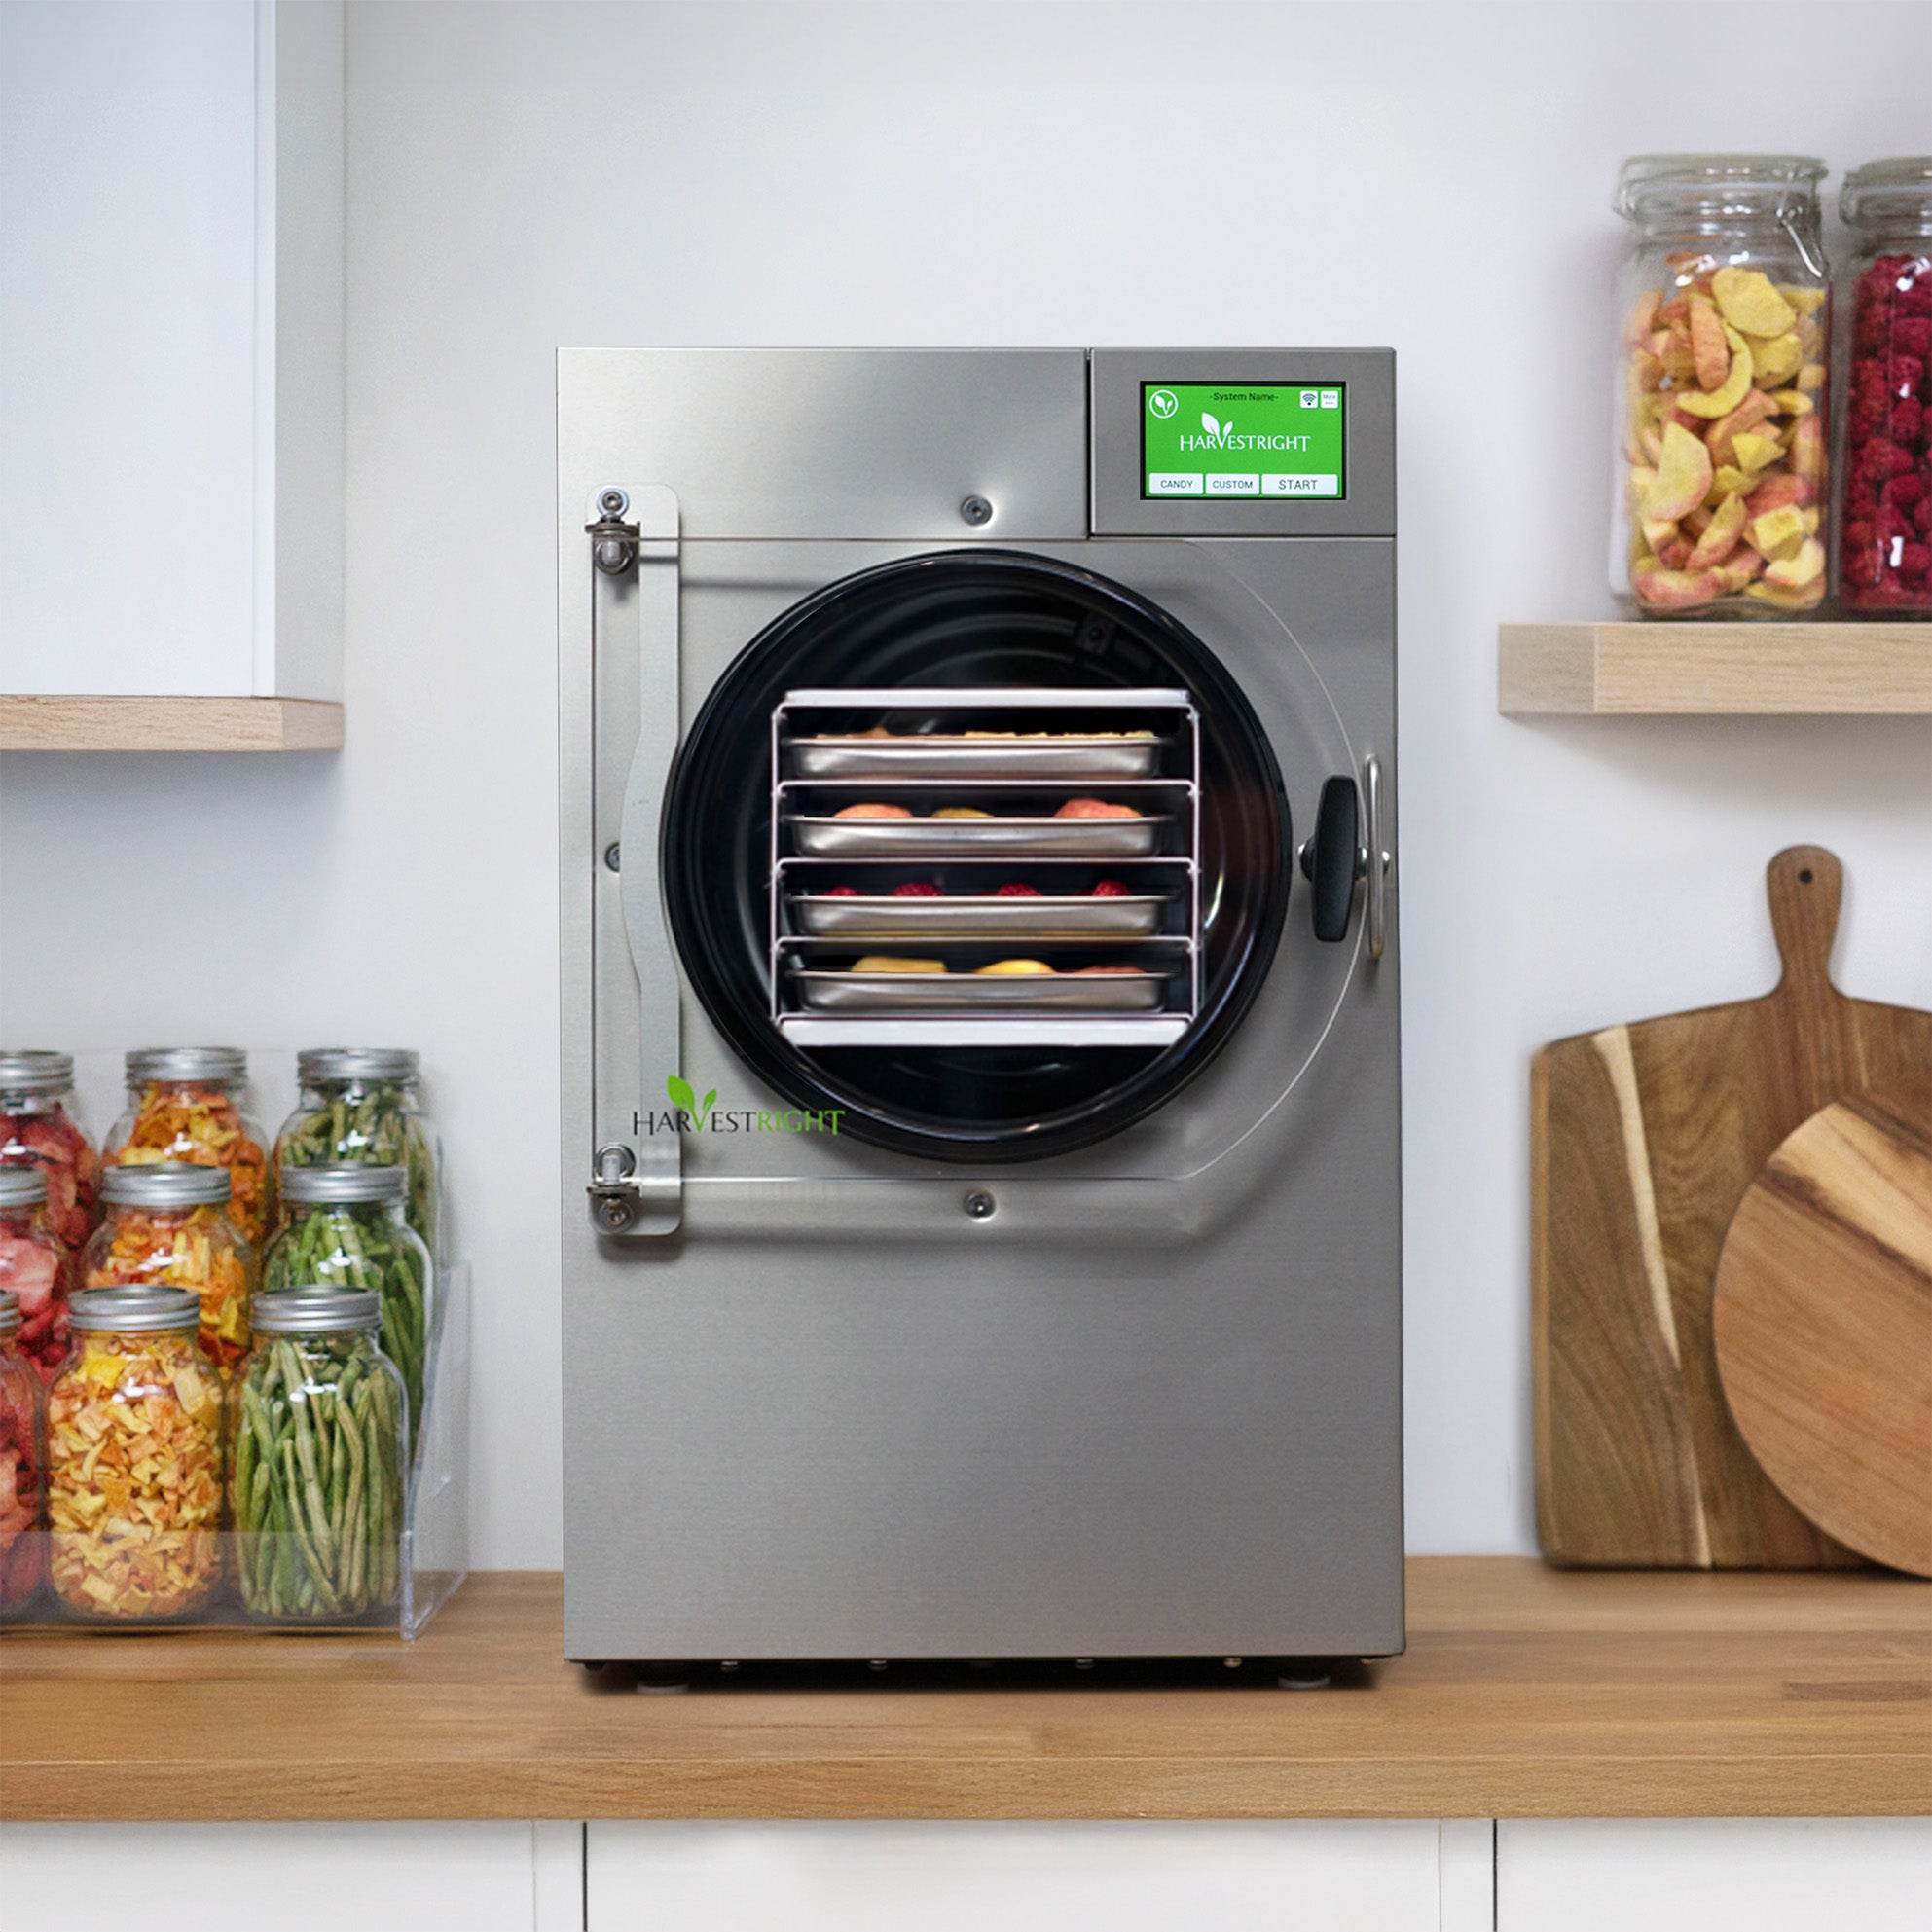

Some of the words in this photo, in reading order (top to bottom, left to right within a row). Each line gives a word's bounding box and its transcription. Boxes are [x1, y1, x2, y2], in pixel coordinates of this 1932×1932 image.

[1210, 392, 1247, 401] -System
[1249, 392, 1278, 401] Name-
[1160, 480, 1193, 489] CANDY
[1213, 480, 1254, 489] CUSTOM
[1279, 480, 1318, 490] START
[634, 1110, 845, 1136] HARVESTRIGHT
